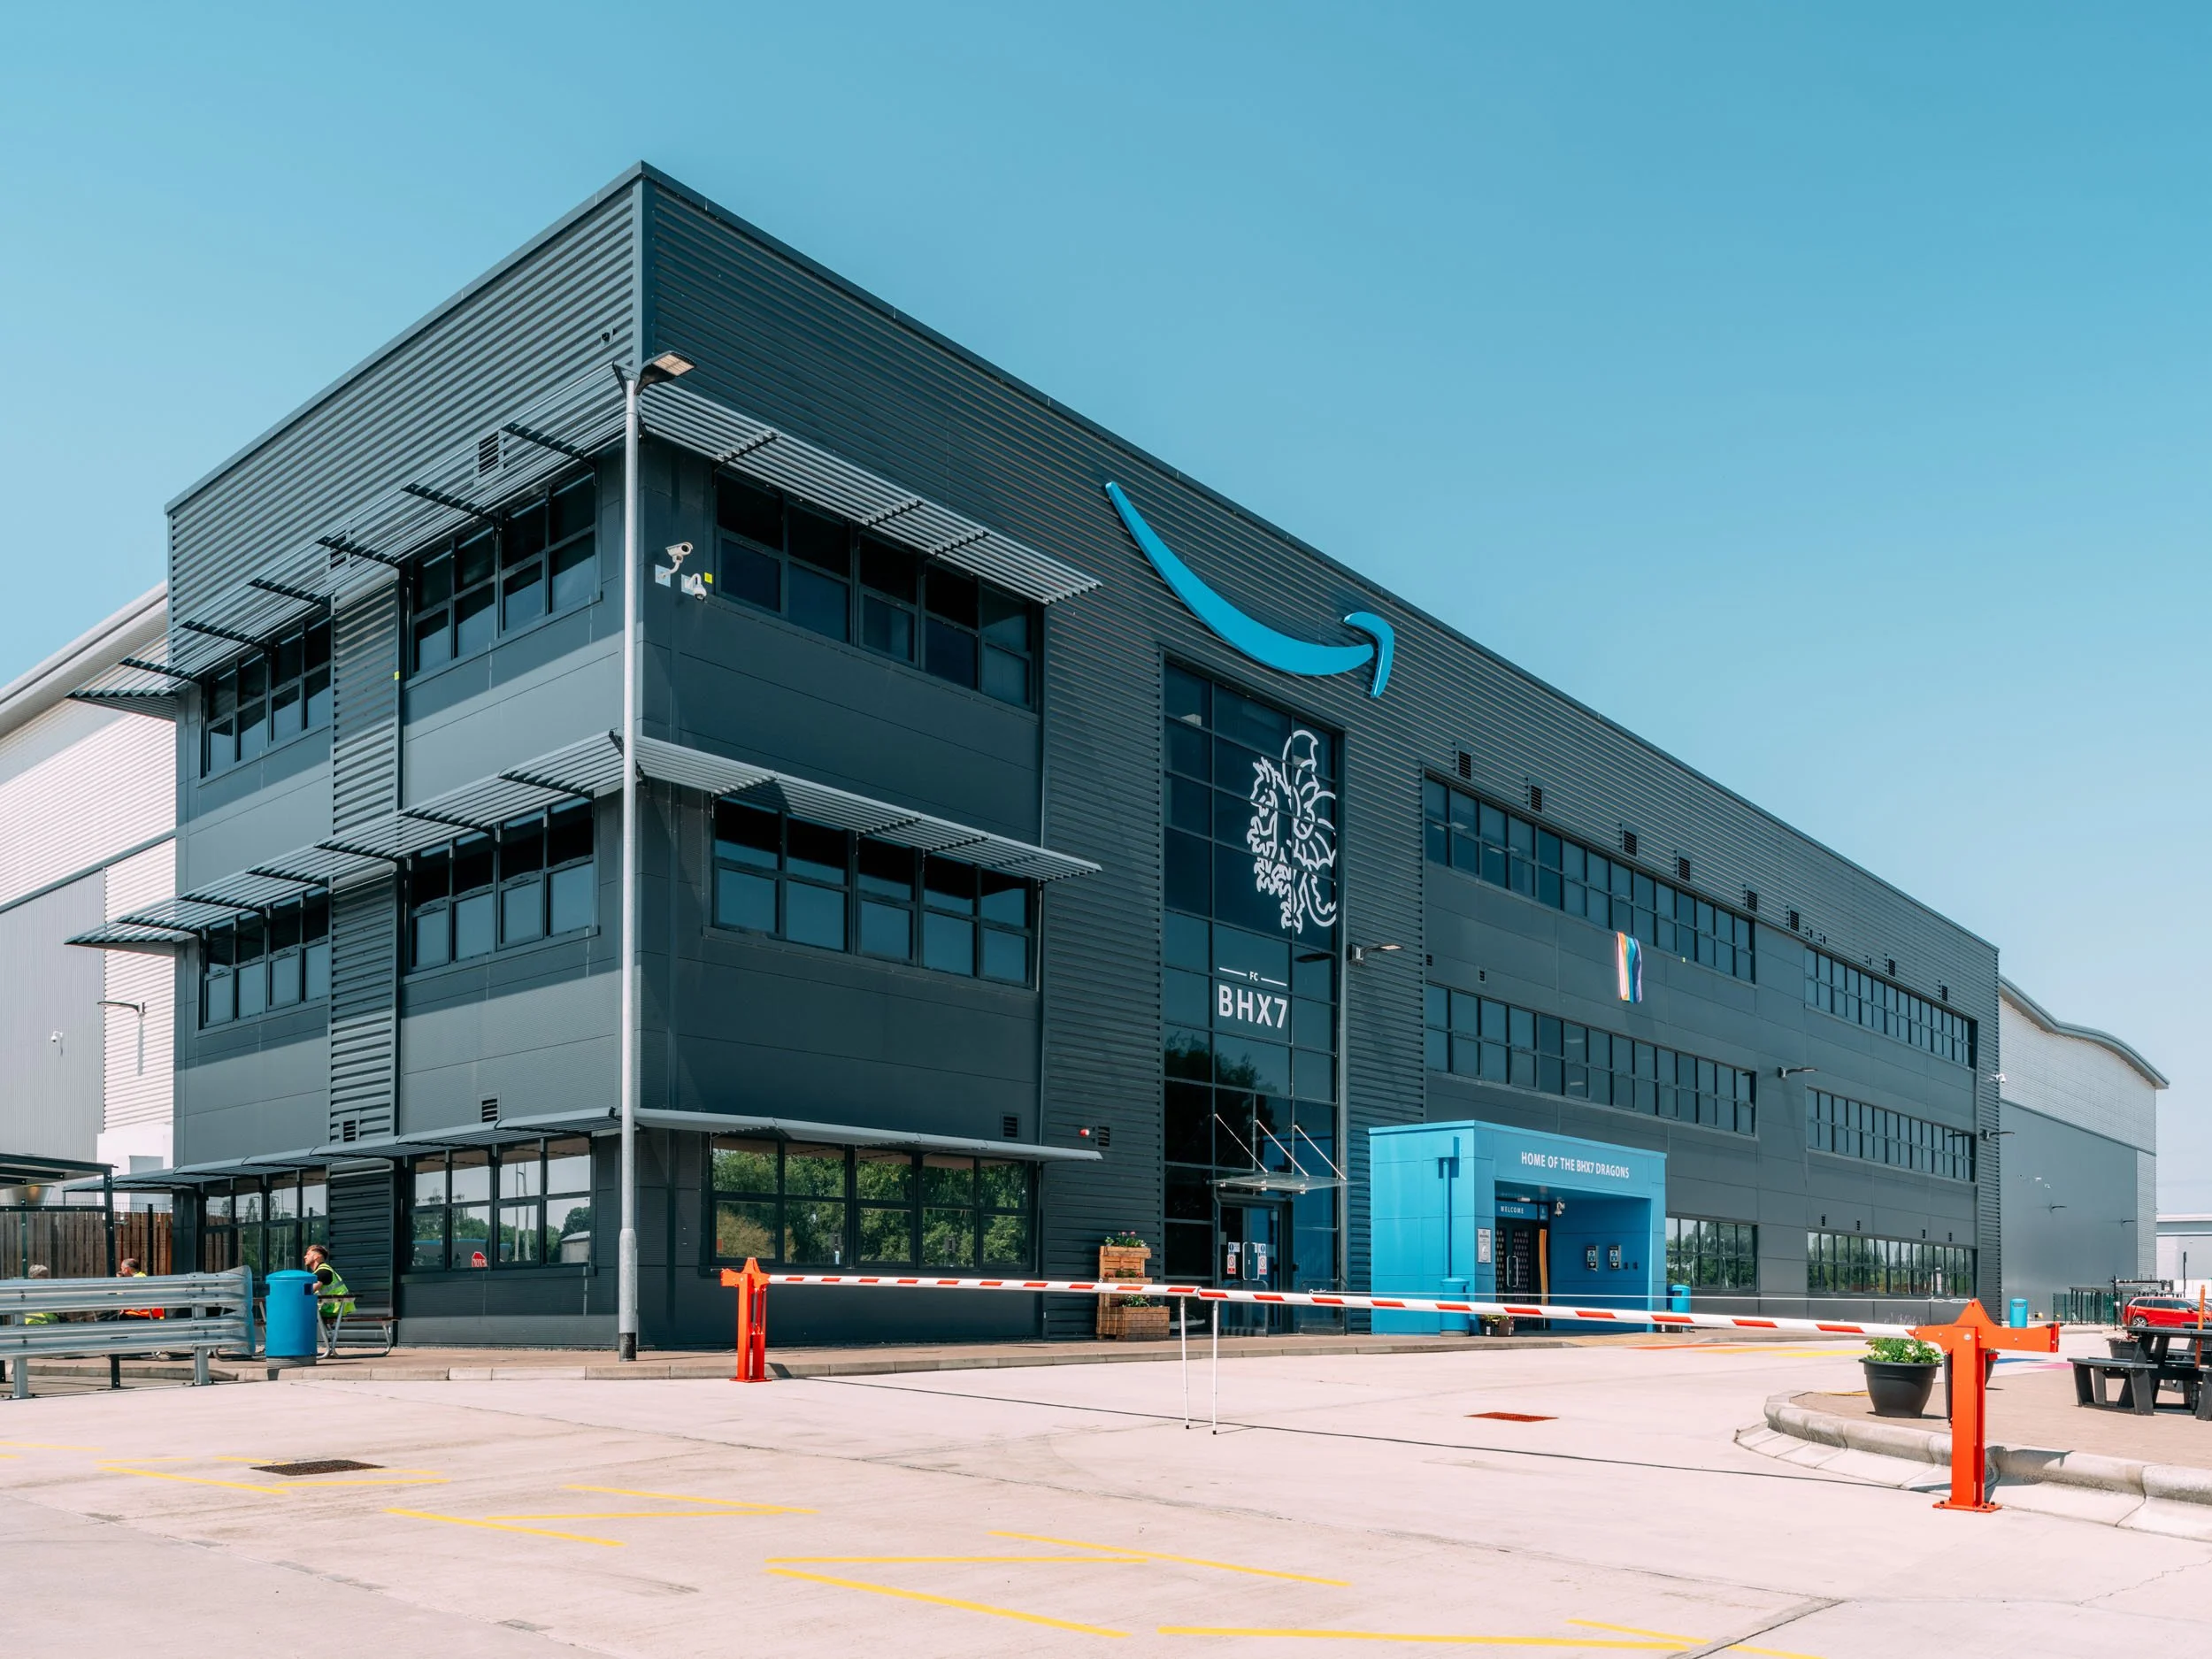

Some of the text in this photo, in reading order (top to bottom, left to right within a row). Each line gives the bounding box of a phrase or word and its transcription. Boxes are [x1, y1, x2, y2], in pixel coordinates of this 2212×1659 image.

[1249, 971, 1258, 981] FC
[1218, 984, 1287, 1028] BHX7
[1521, 1151, 1630, 1179] HOME OF THE BHX7 DRAGONS
[1500, 1205, 1525, 1215] WELCOME
